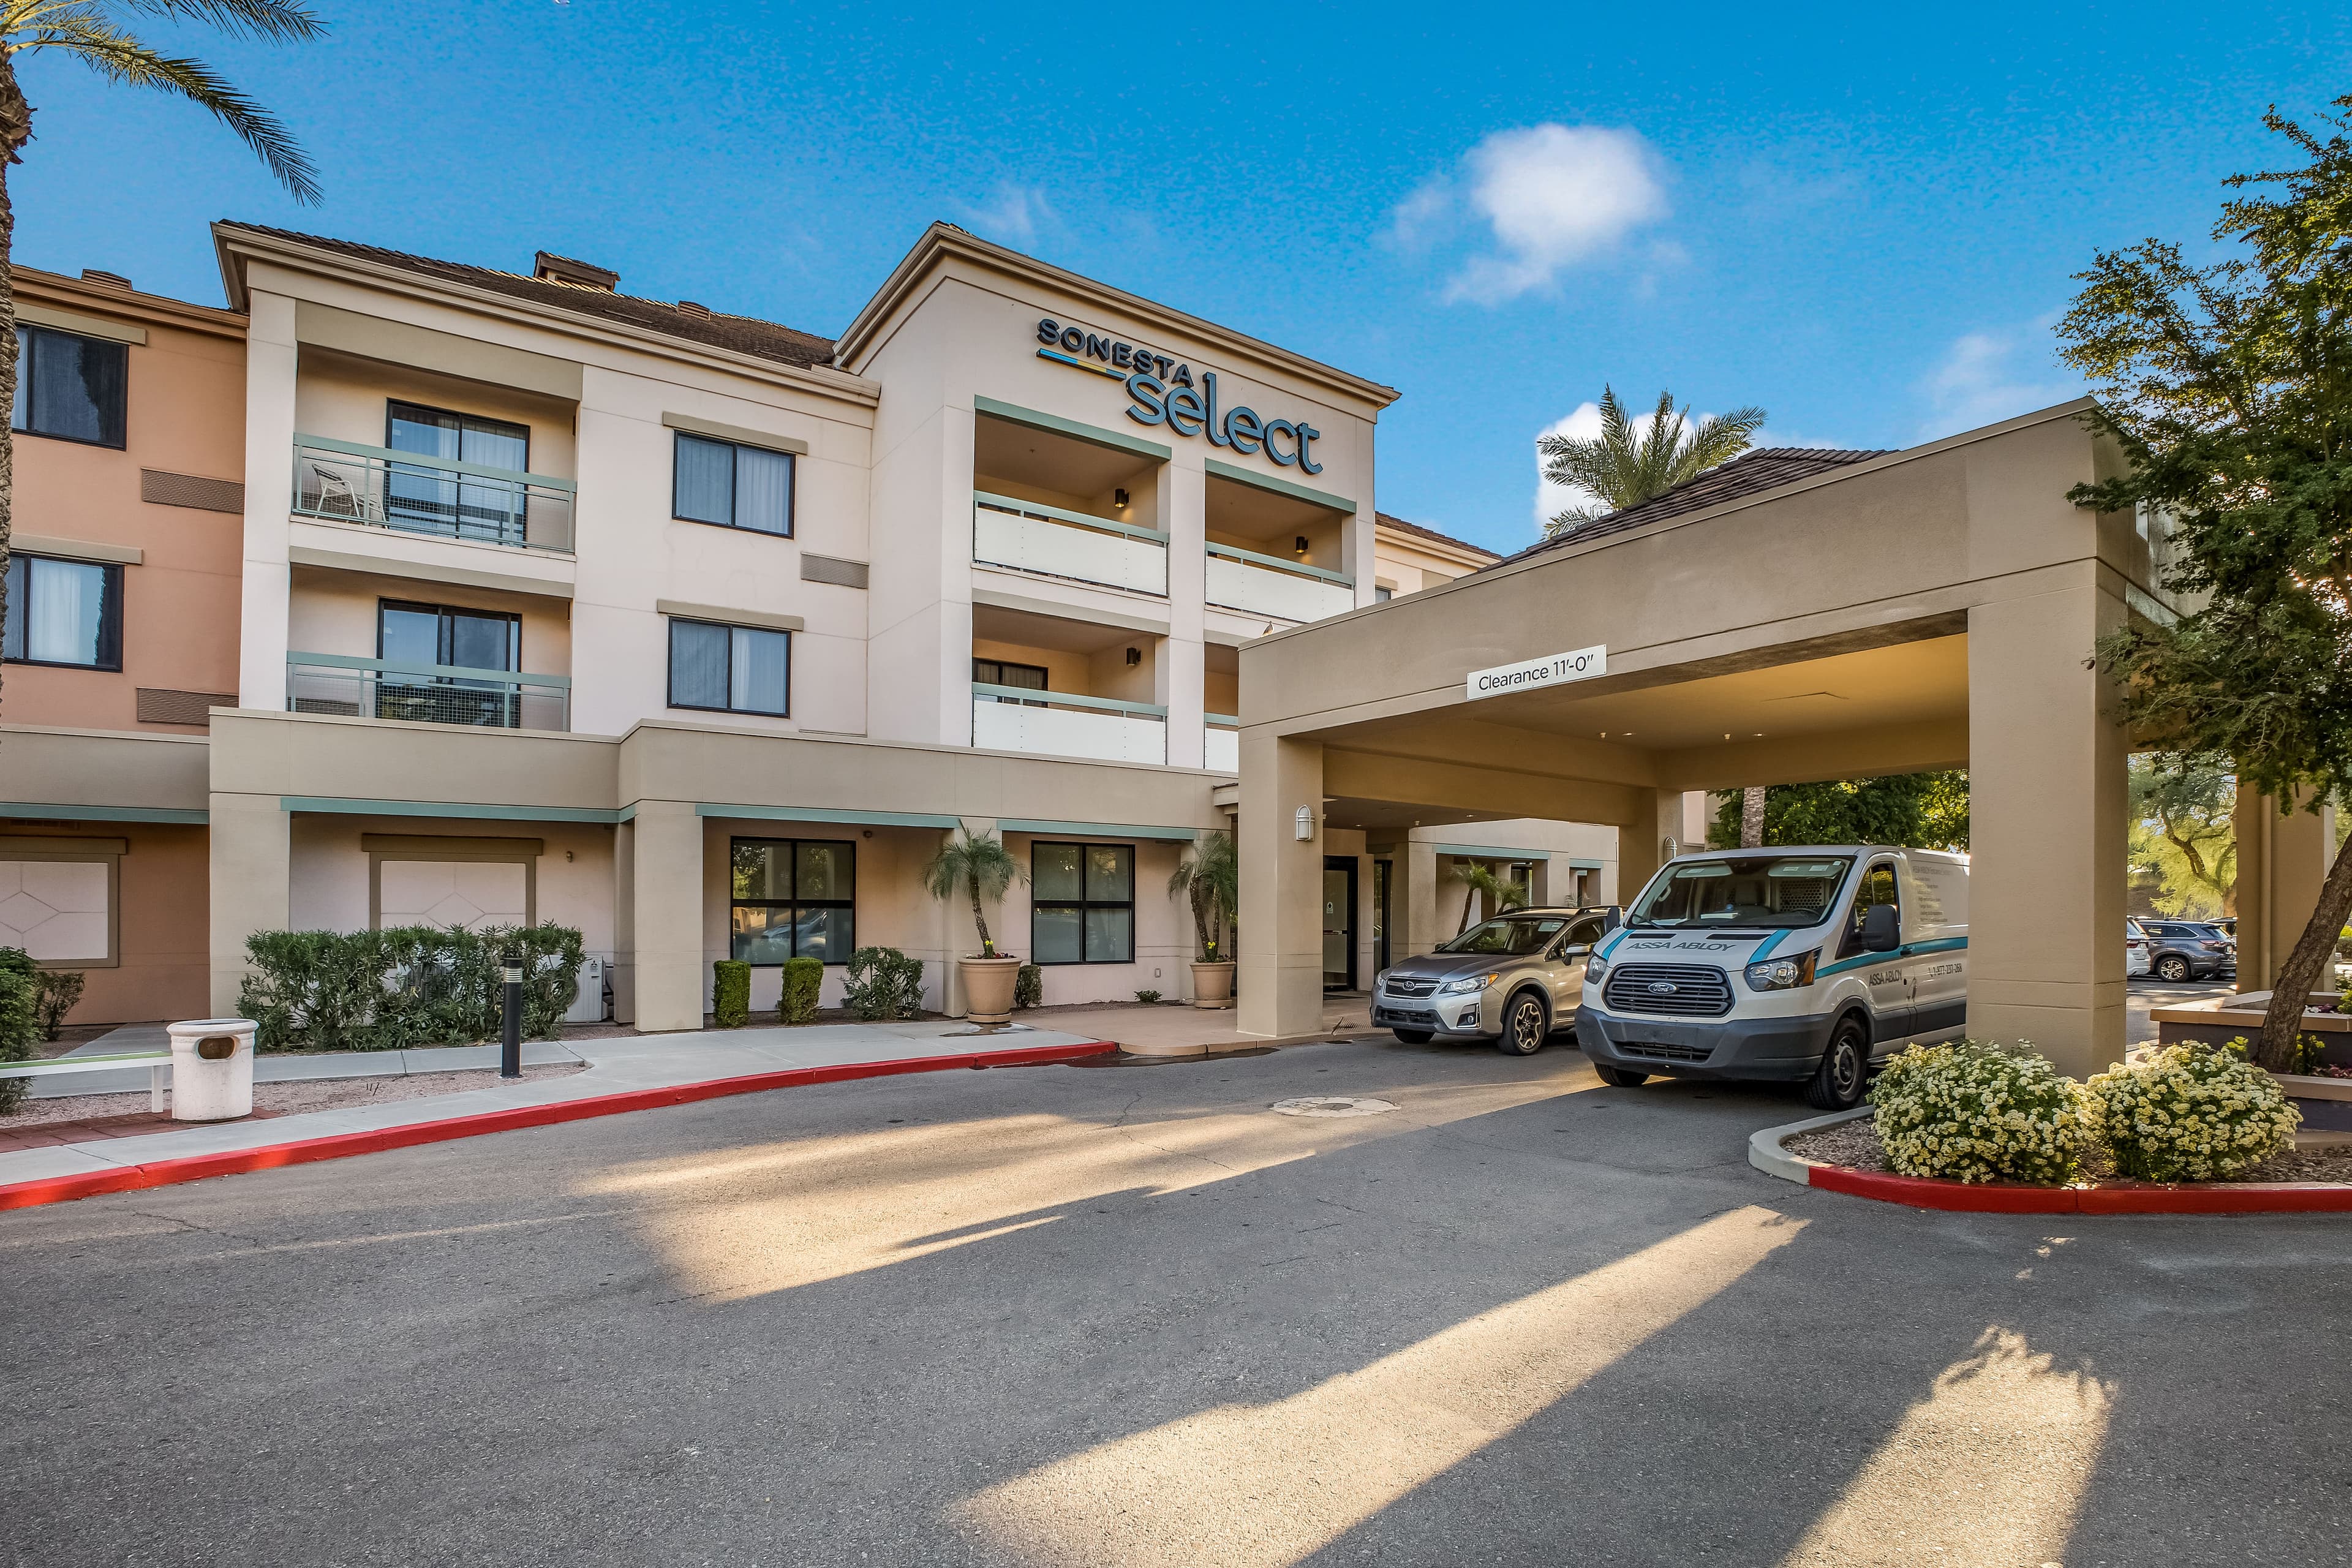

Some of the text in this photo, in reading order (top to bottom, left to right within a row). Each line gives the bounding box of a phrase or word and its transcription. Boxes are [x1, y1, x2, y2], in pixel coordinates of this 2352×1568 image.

[1036, 318, 1194, 387] SONESTA
[1125, 371, 1324, 475] select
[1479, 667, 1548, 690] Clearance
[1673, 942, 1736, 951] ABLOY
[1869, 969, 1902, 986] ASSA ABLOY
